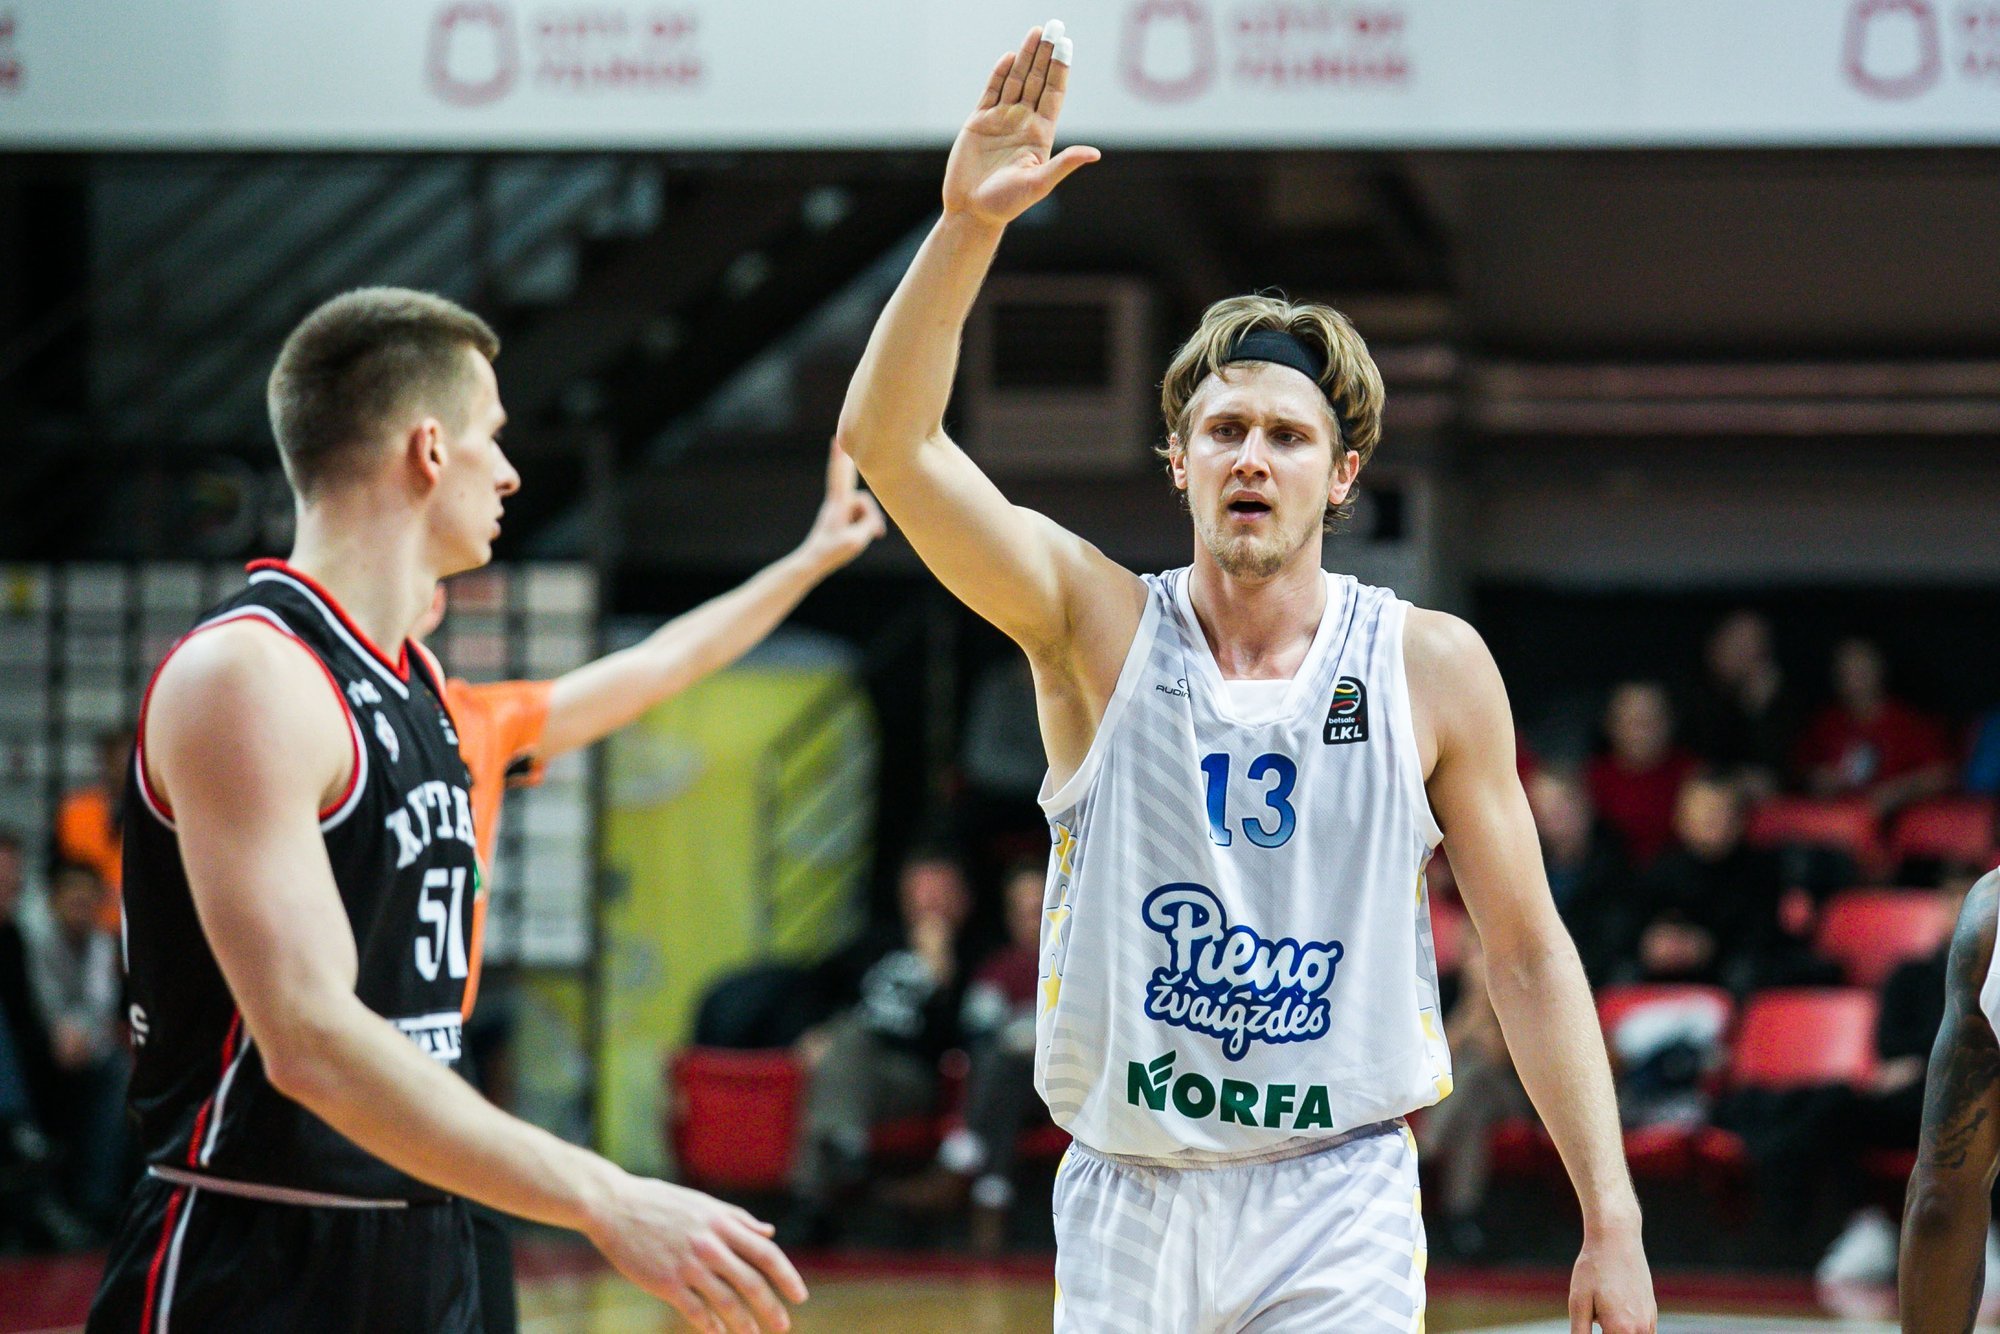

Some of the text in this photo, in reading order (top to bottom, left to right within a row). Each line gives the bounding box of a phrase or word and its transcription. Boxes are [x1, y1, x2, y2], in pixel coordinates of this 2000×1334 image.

[1330, 725, 1363, 740] LKL
[1200, 752, 1299, 849] 13
[414, 866, 468, 982] 51
[1145, 885, 1341, 992] Pieno
[1127, 1050, 1335, 1130] NORFA
